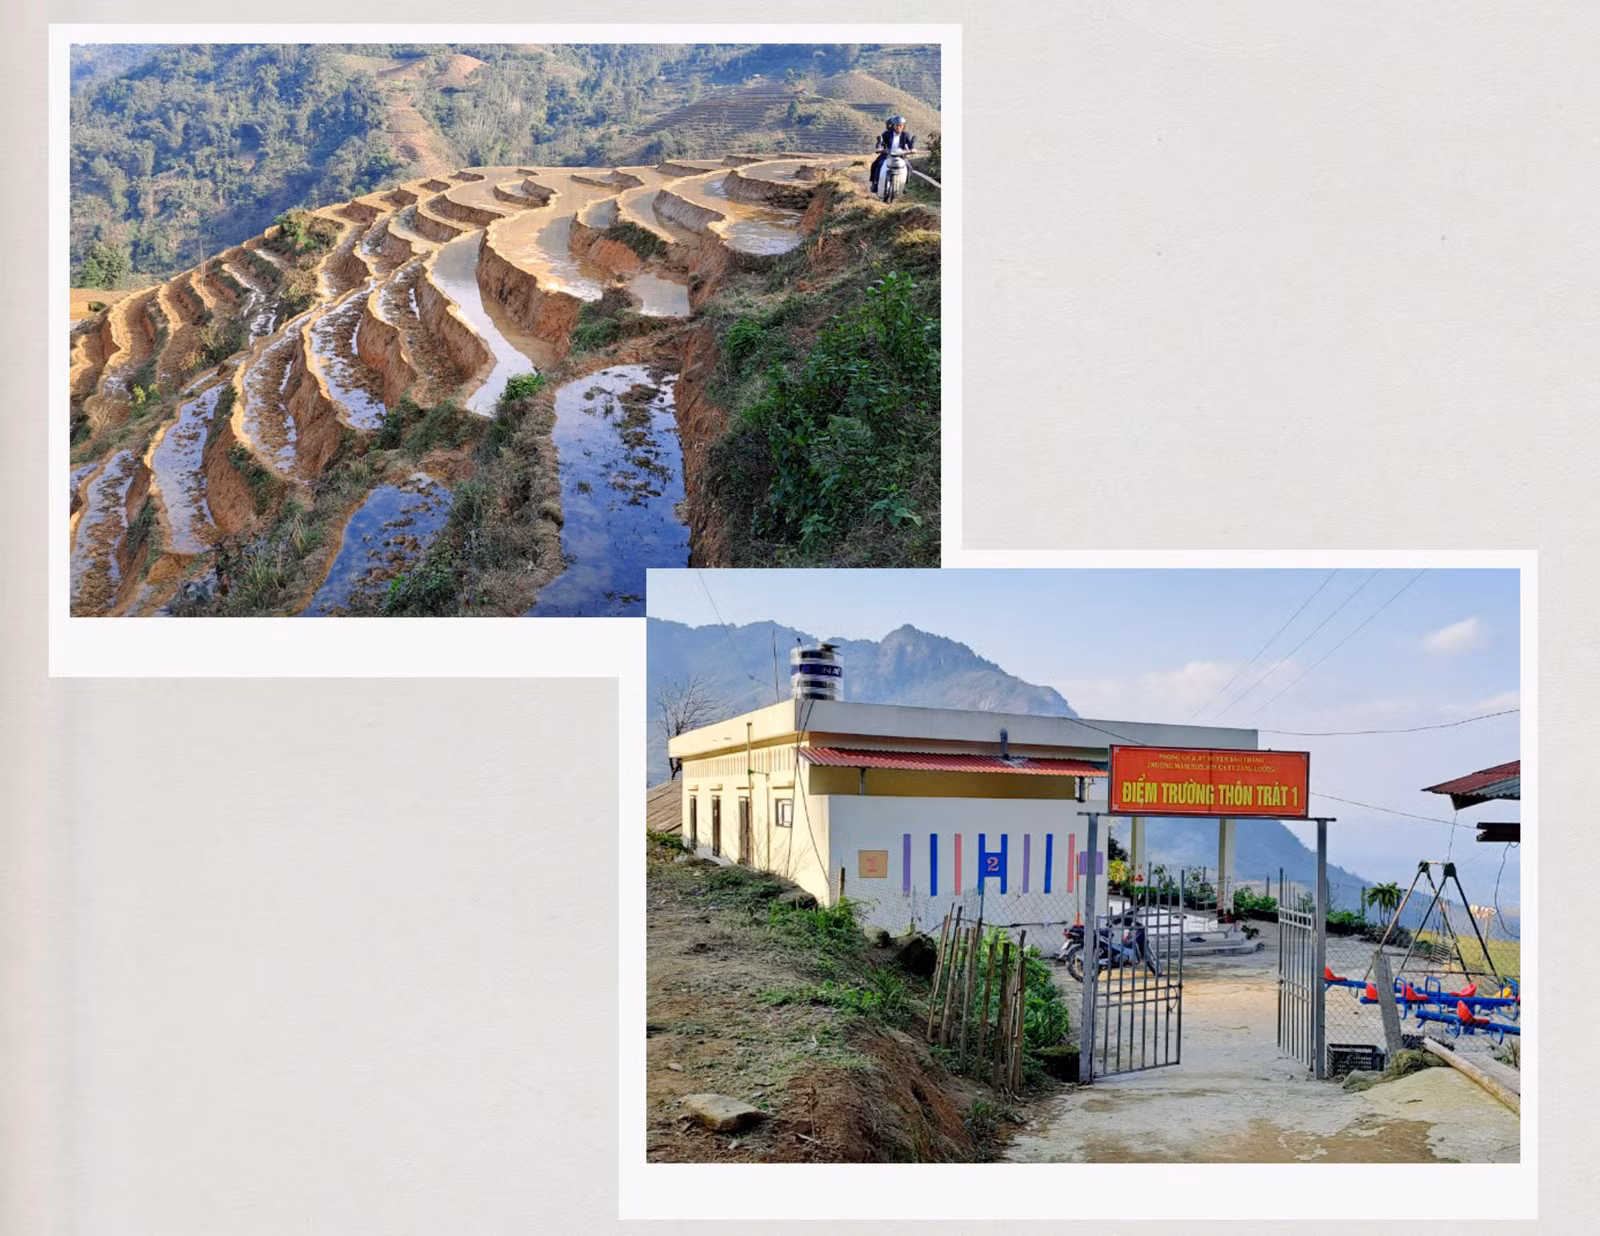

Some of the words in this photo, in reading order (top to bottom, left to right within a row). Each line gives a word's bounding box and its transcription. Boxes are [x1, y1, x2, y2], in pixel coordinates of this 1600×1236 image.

[1122, 773, 1158, 806] ĐIỂM
[1161, 778, 1215, 805] TRƯỜNG
[1218, 780, 1253, 806] THÔN
[1257, 781, 1288, 806] TRÁT
[1292, 786, 1298, 807] 1
[987, 856, 999, 872] 2
